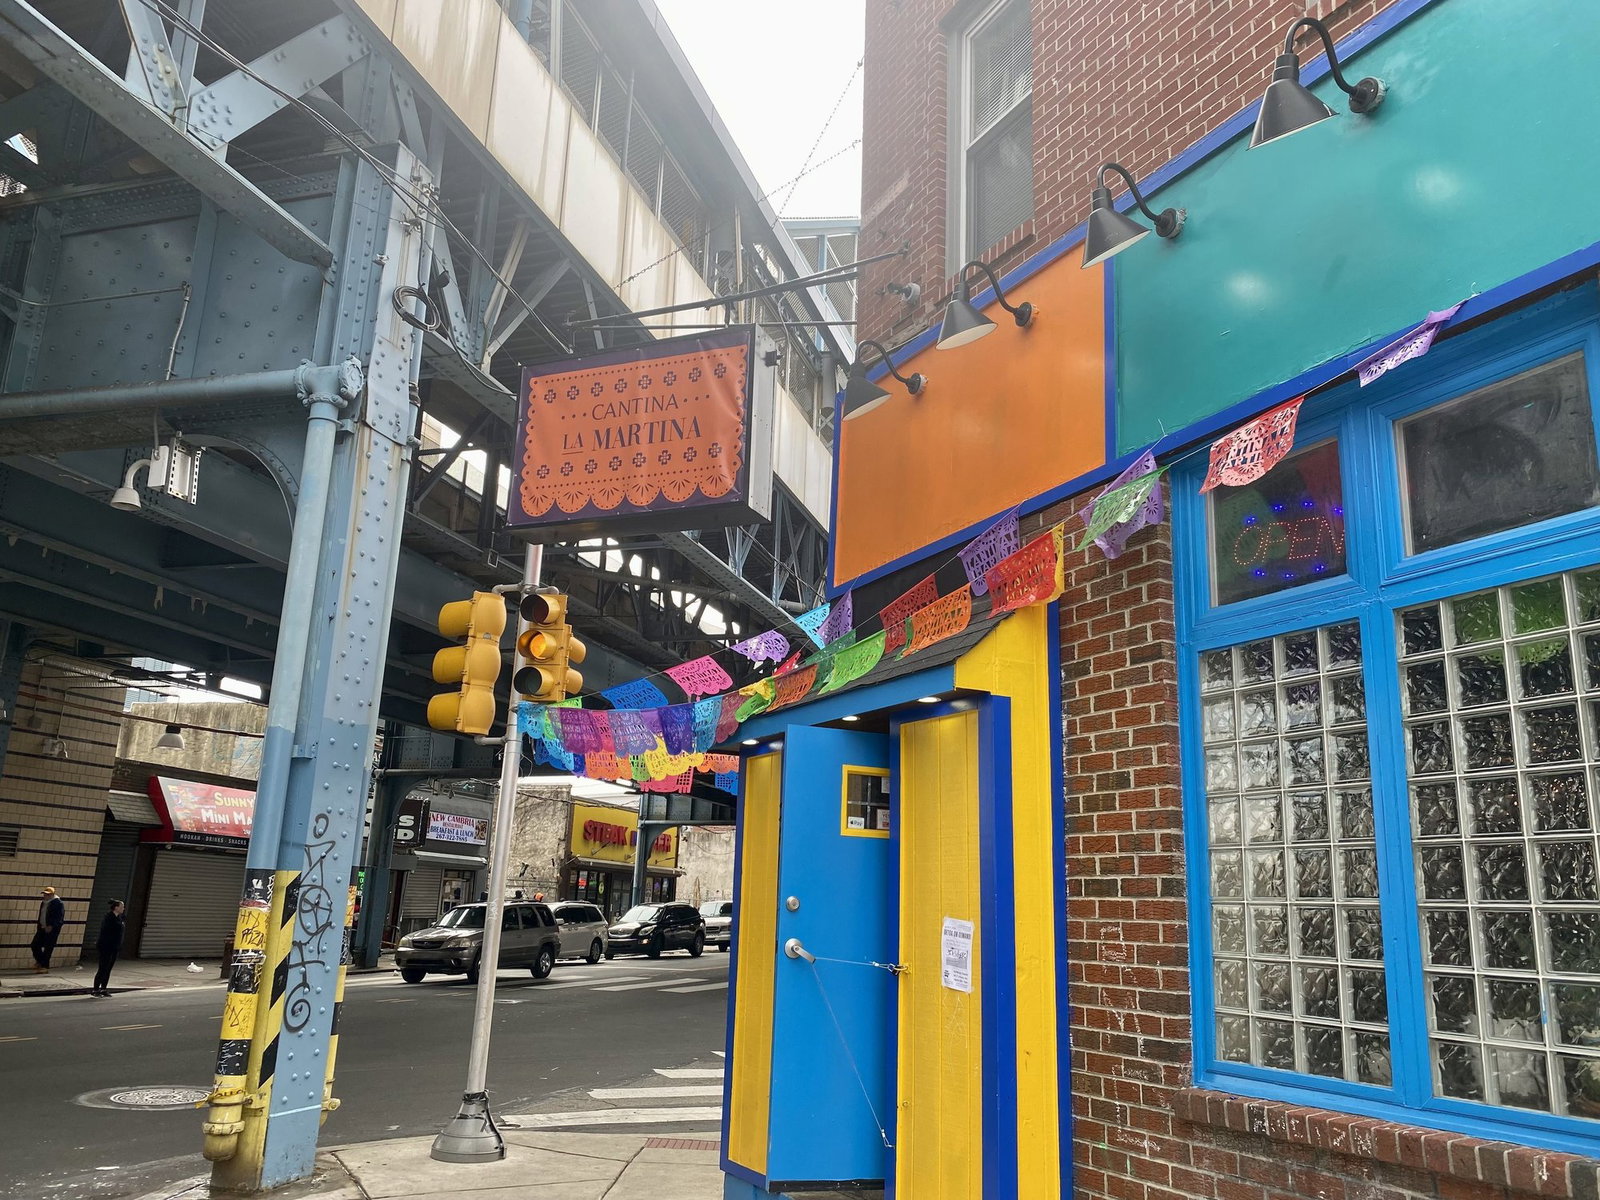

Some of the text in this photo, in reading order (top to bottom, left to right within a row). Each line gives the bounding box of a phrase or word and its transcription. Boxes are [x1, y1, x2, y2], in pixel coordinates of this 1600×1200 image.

[592, 393, 680, 421] CANTINA
[562, 416, 702, 452] LA MARTINA
[1234, 515, 1345, 566] OPEN
[202, 809, 230, 824] MINI
[431, 813, 475, 828] NEW CAMBRIA
[205, 835, 224, 843] DRINKS
[228, 838, 247, 846] SNACKS
[584, 819, 628, 846] STEAK
